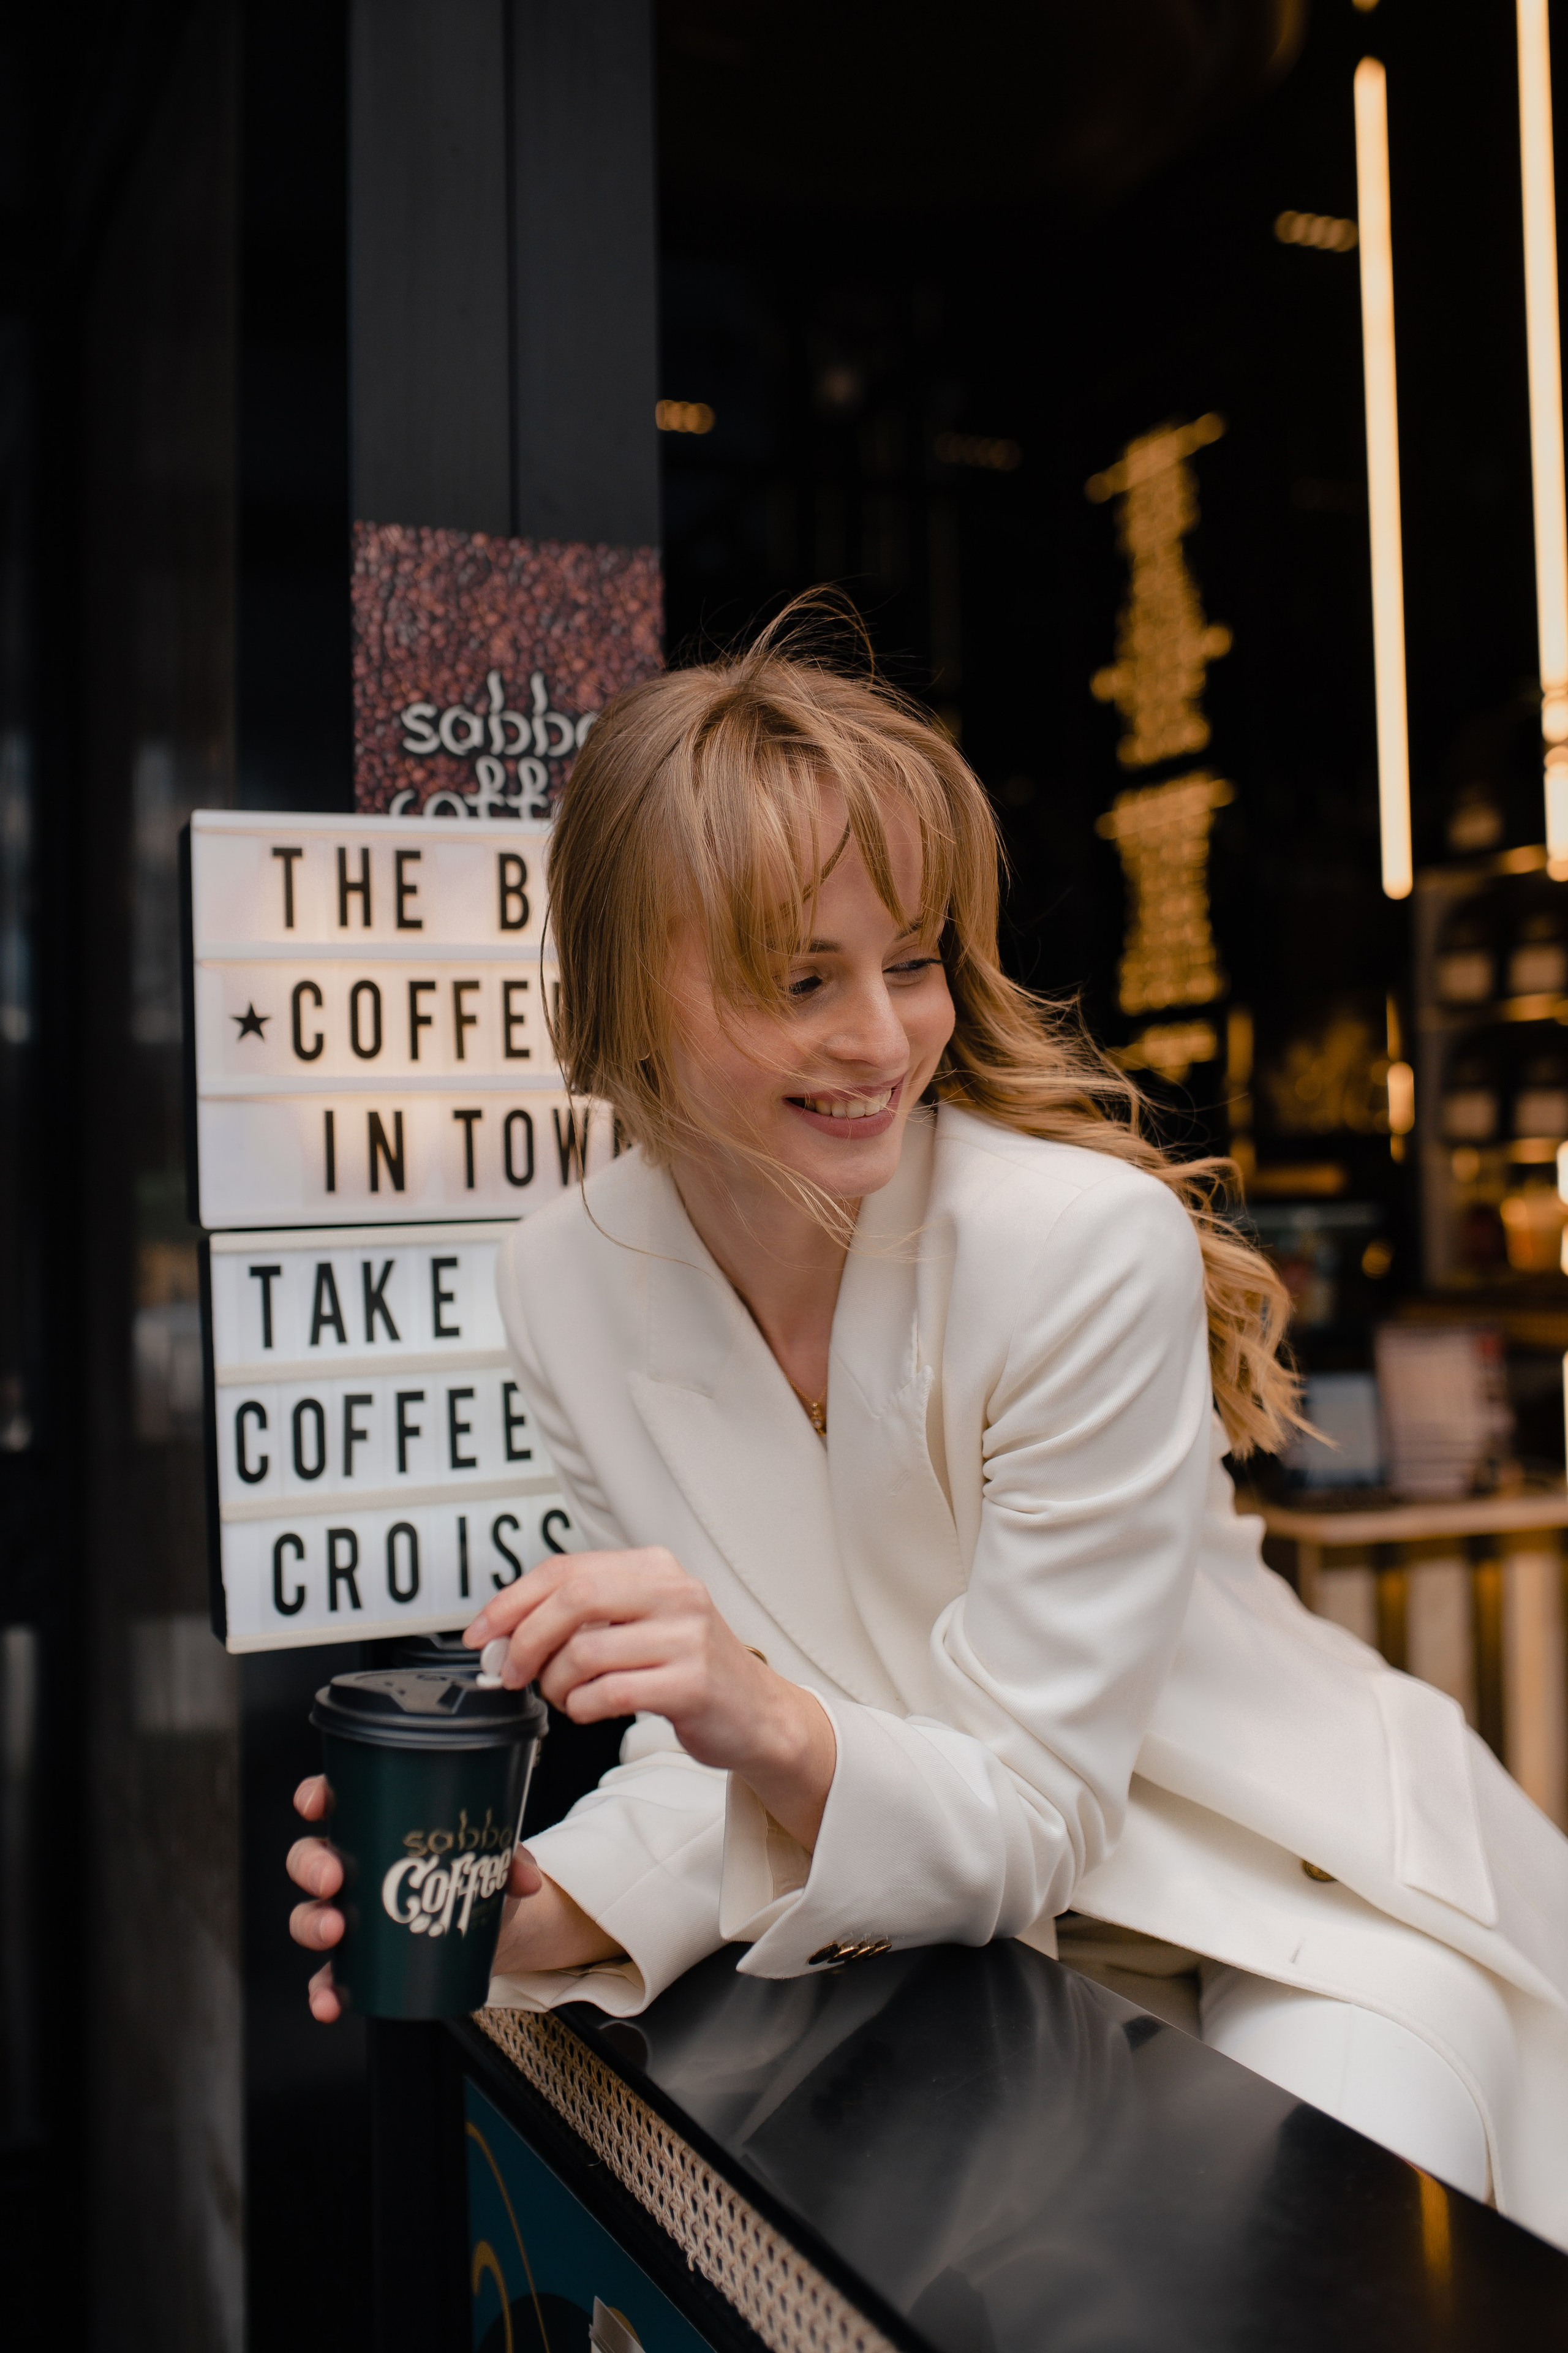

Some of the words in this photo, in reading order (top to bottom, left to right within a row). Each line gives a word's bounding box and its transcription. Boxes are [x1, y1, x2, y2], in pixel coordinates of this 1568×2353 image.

[390, 755, 561, 819] coff
[271, 847, 424, 931] THE
[292, 980, 560, 1062] COFFE
[324, 1111, 405, 1192] IN
[250, 1256, 461, 1350] TAKE
[235, 1381, 532, 1484] COFFEE
[382, 1848, 512, 1938] Coffee
